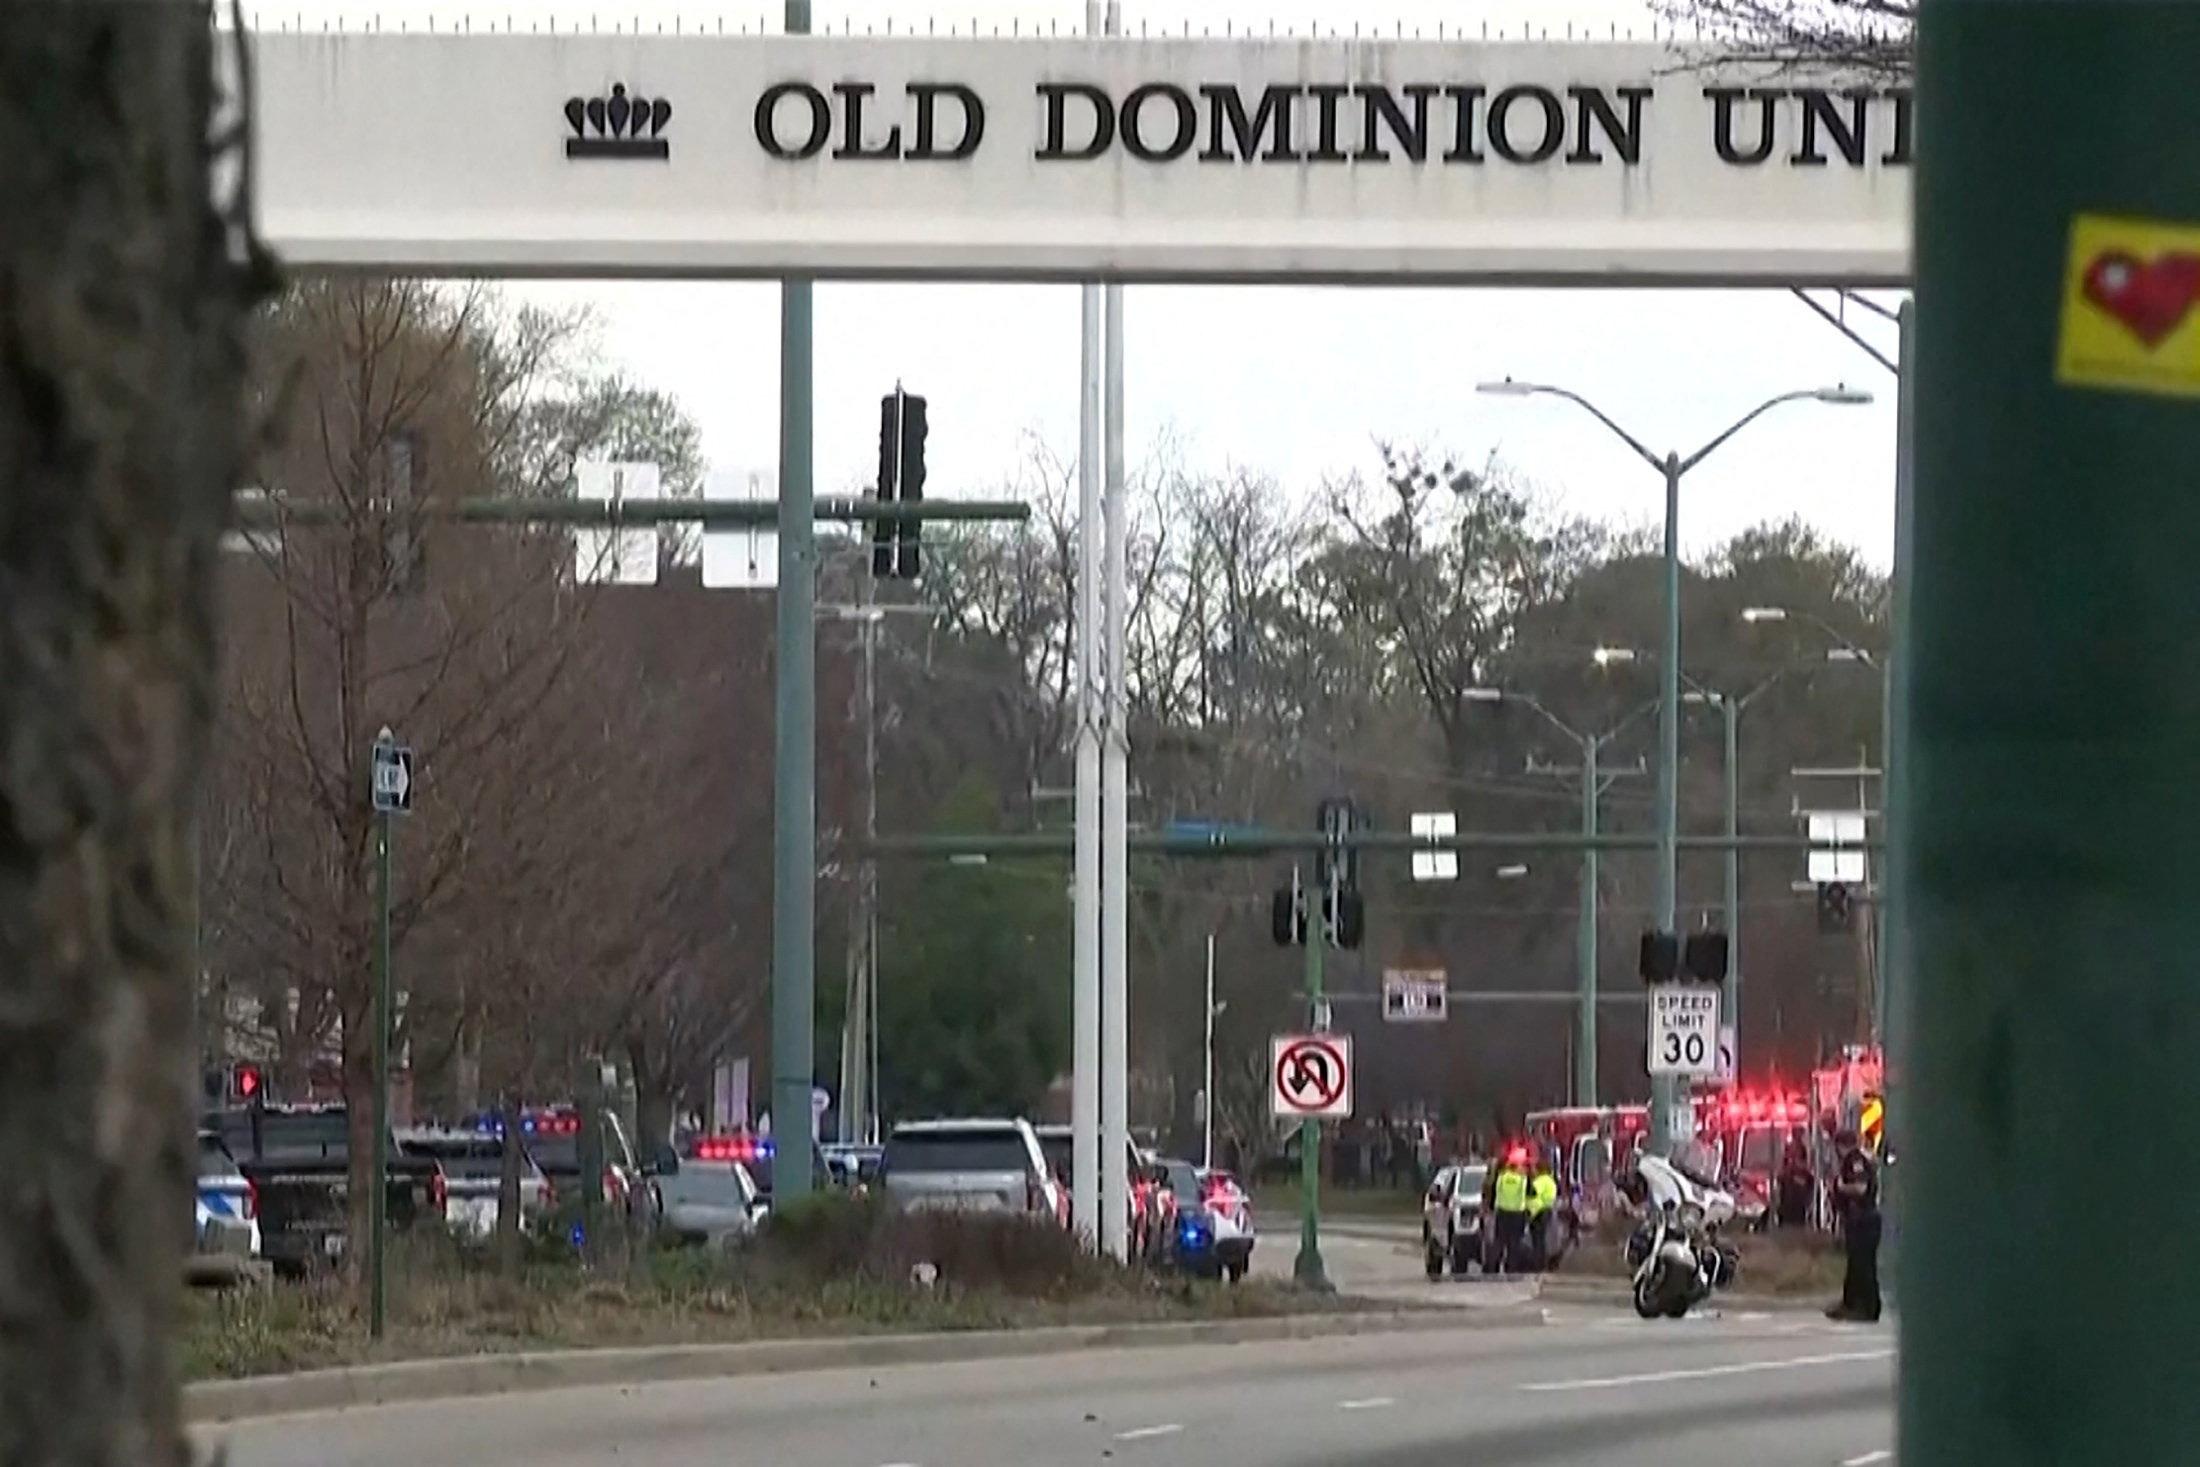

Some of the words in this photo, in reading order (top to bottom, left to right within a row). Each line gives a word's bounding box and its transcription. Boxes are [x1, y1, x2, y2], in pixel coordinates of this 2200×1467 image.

[754, 82, 985, 160] OLD
[1034, 83, 1655, 165] DOMINION
[1703, 87, 1914, 168] UNI
[1657, 995, 1713, 1010] SPEED
[1662, 1014, 1704, 1029] LIMIT
[1664, 1032, 1704, 1066] 30
